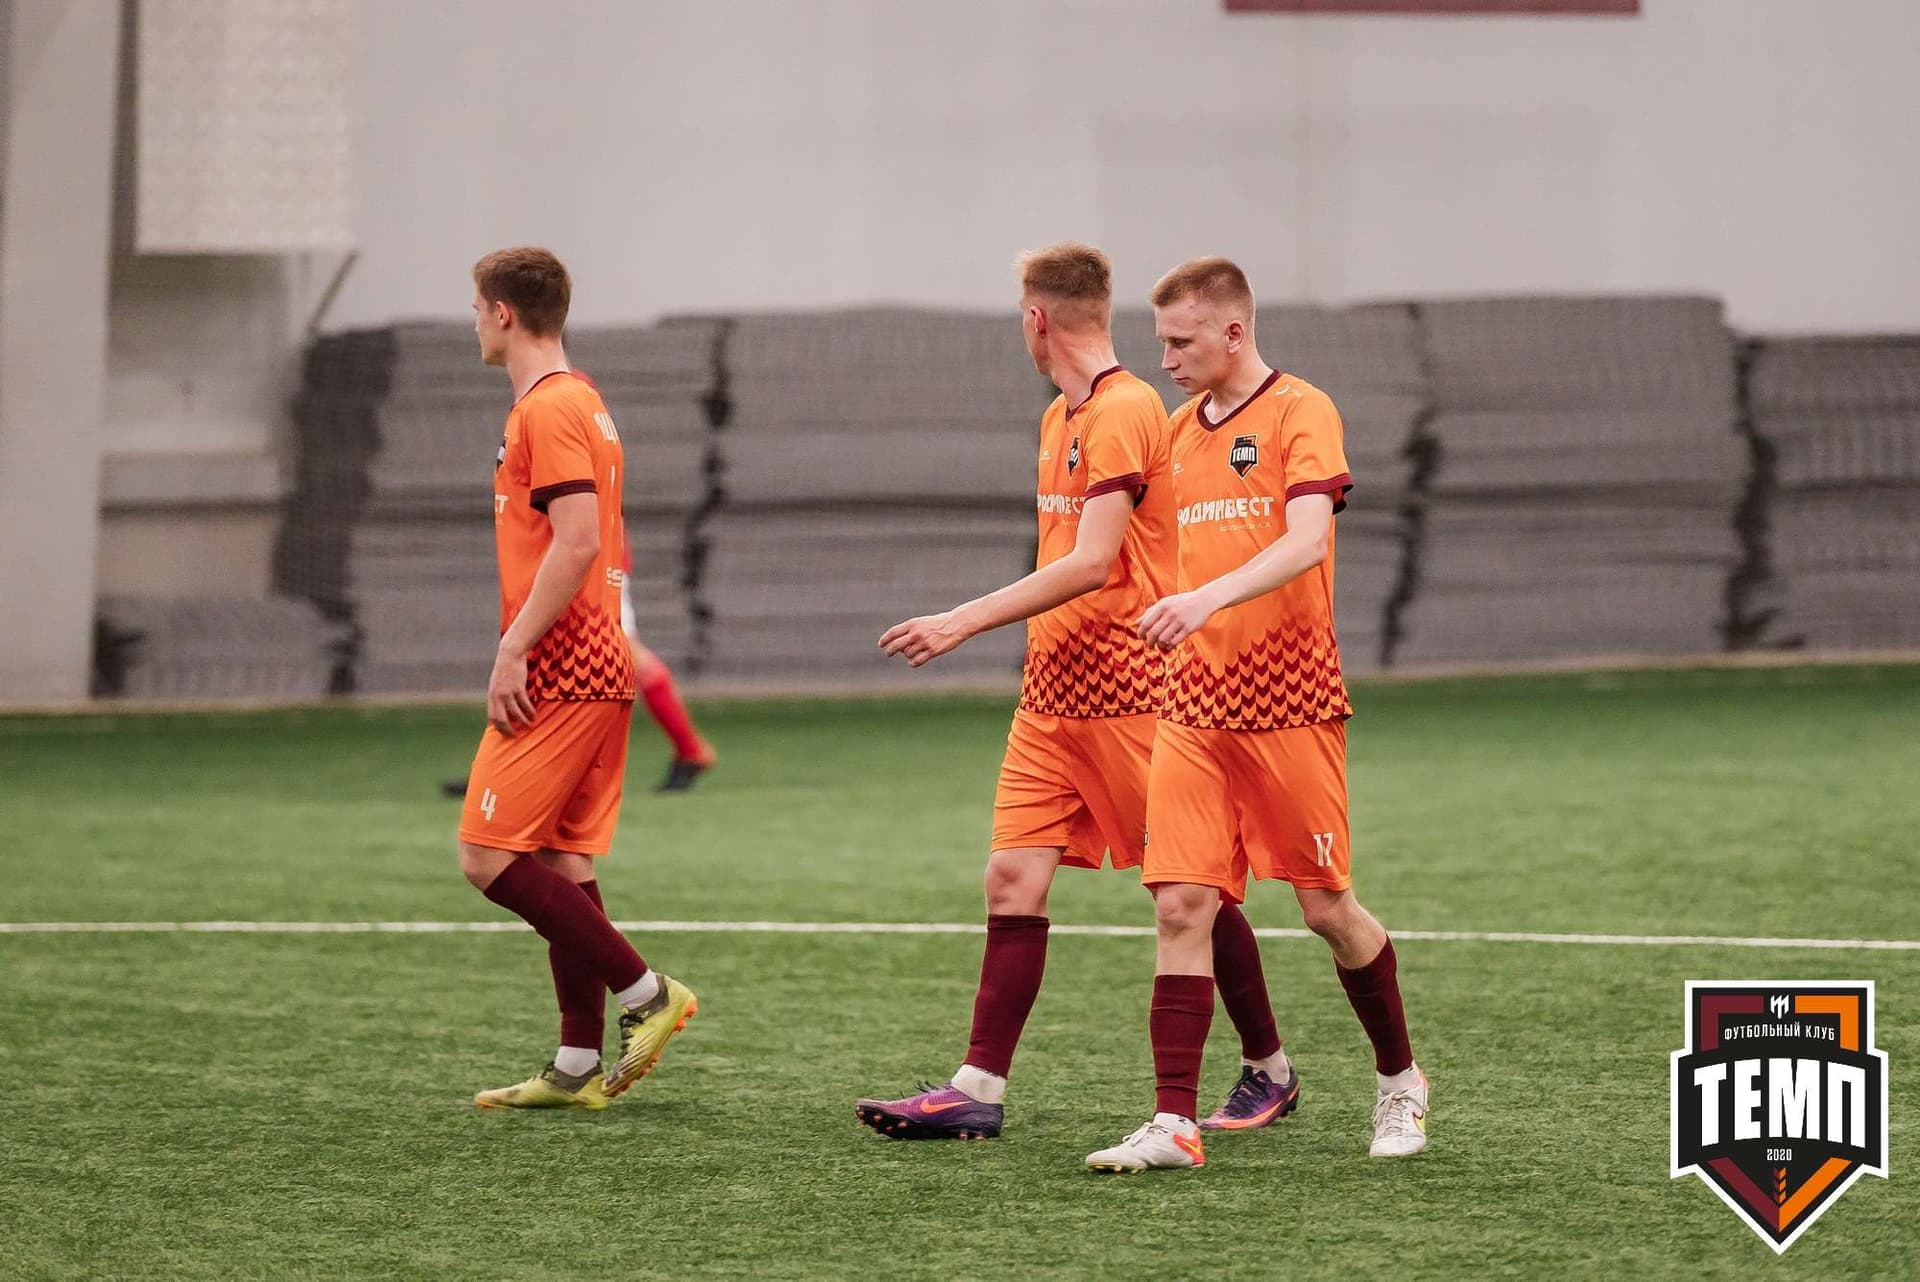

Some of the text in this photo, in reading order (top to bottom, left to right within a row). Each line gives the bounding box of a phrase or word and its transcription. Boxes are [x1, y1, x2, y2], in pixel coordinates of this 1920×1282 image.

[1232, 446, 1256, 463] ТЕМП
[480, 787, 497, 821] 4
[1312, 832, 1334, 867] 17
